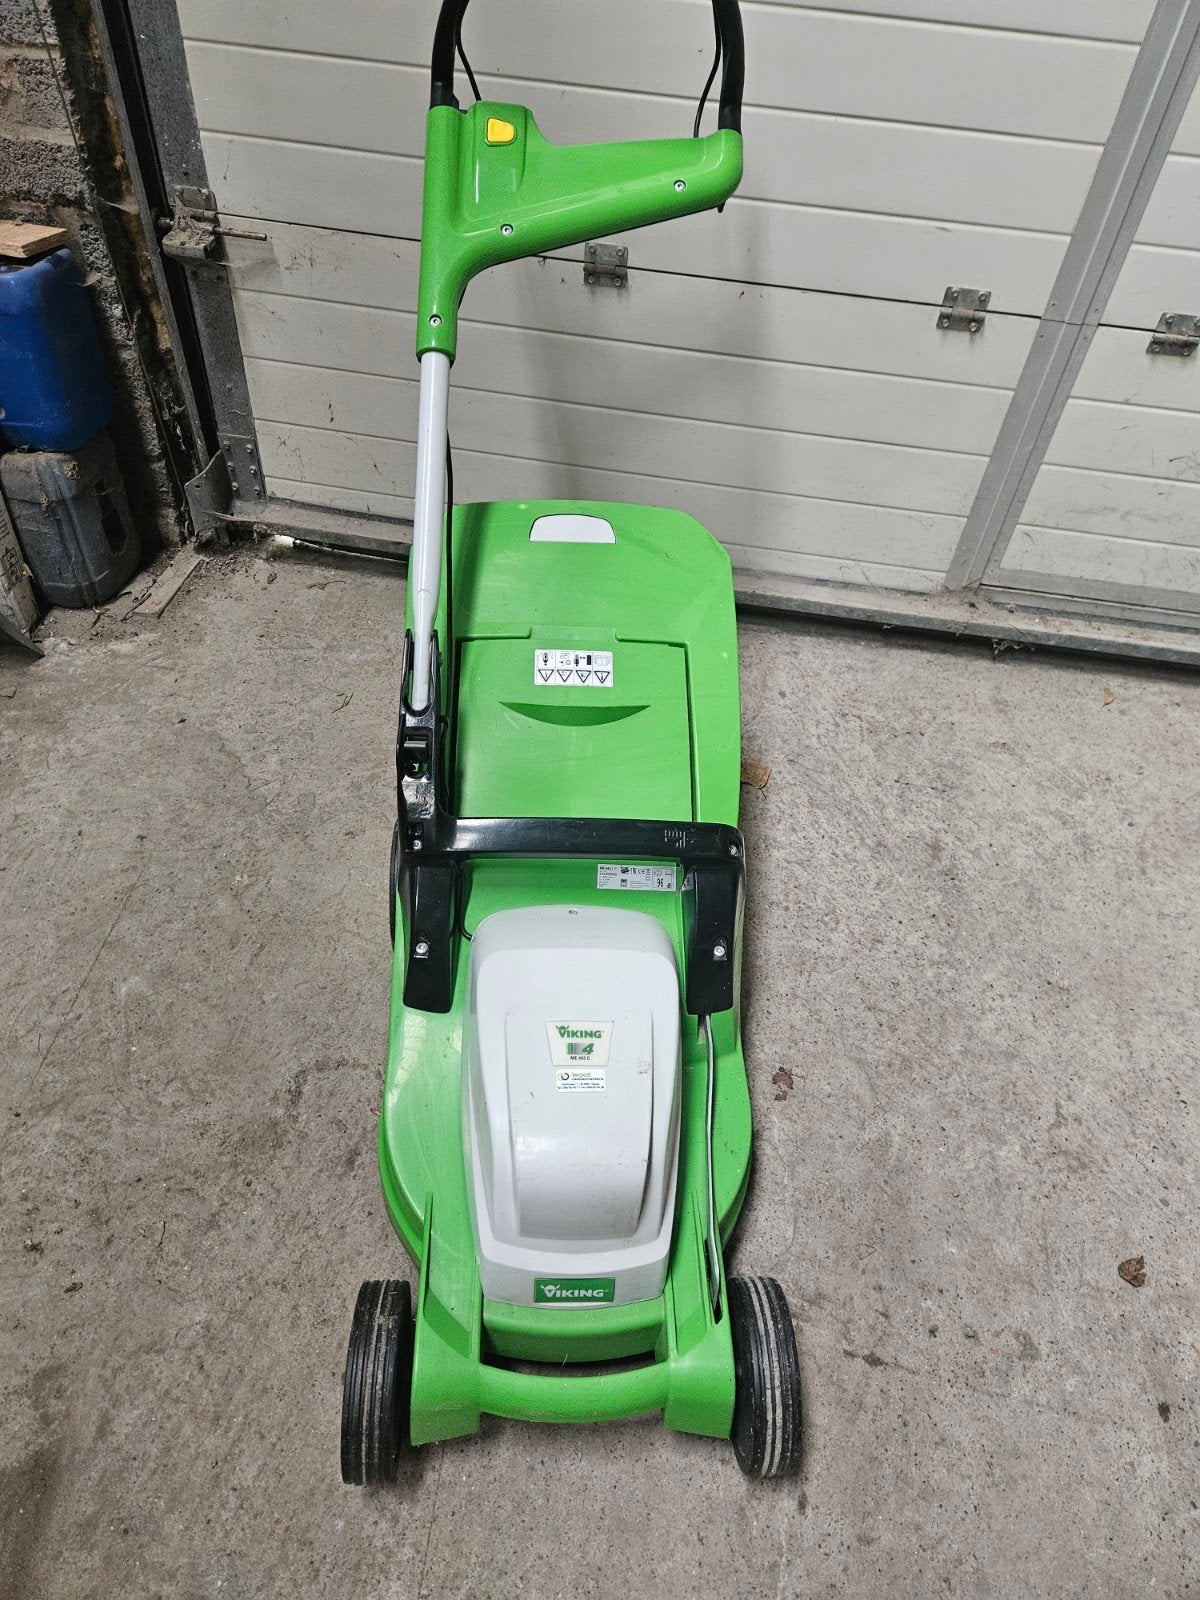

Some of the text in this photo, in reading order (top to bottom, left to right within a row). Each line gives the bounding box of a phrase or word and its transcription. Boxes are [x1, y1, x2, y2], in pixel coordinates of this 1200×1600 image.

[556, 1026, 602, 1039] VIKING
[581, 1043, 594, 1055] 4
[541, 1285, 604, 1298] VIKING
